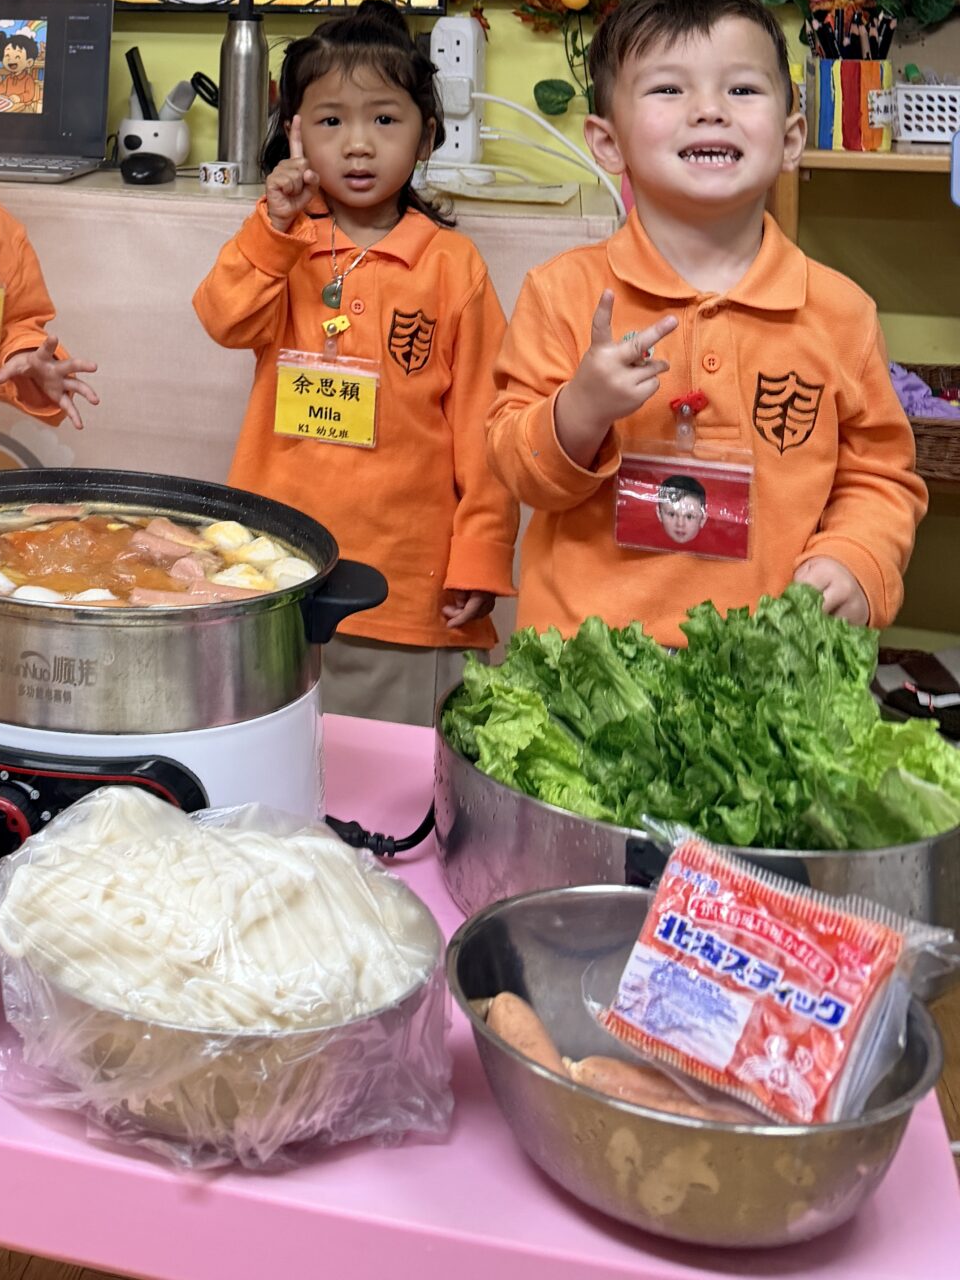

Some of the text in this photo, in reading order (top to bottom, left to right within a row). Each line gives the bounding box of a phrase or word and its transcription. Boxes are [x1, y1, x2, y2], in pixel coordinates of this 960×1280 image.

[308, 405, 341, 422] Mila
[297, 423, 349, 439] K1 幼兒班
[656, 913, 846, 1026] 北海スティック
